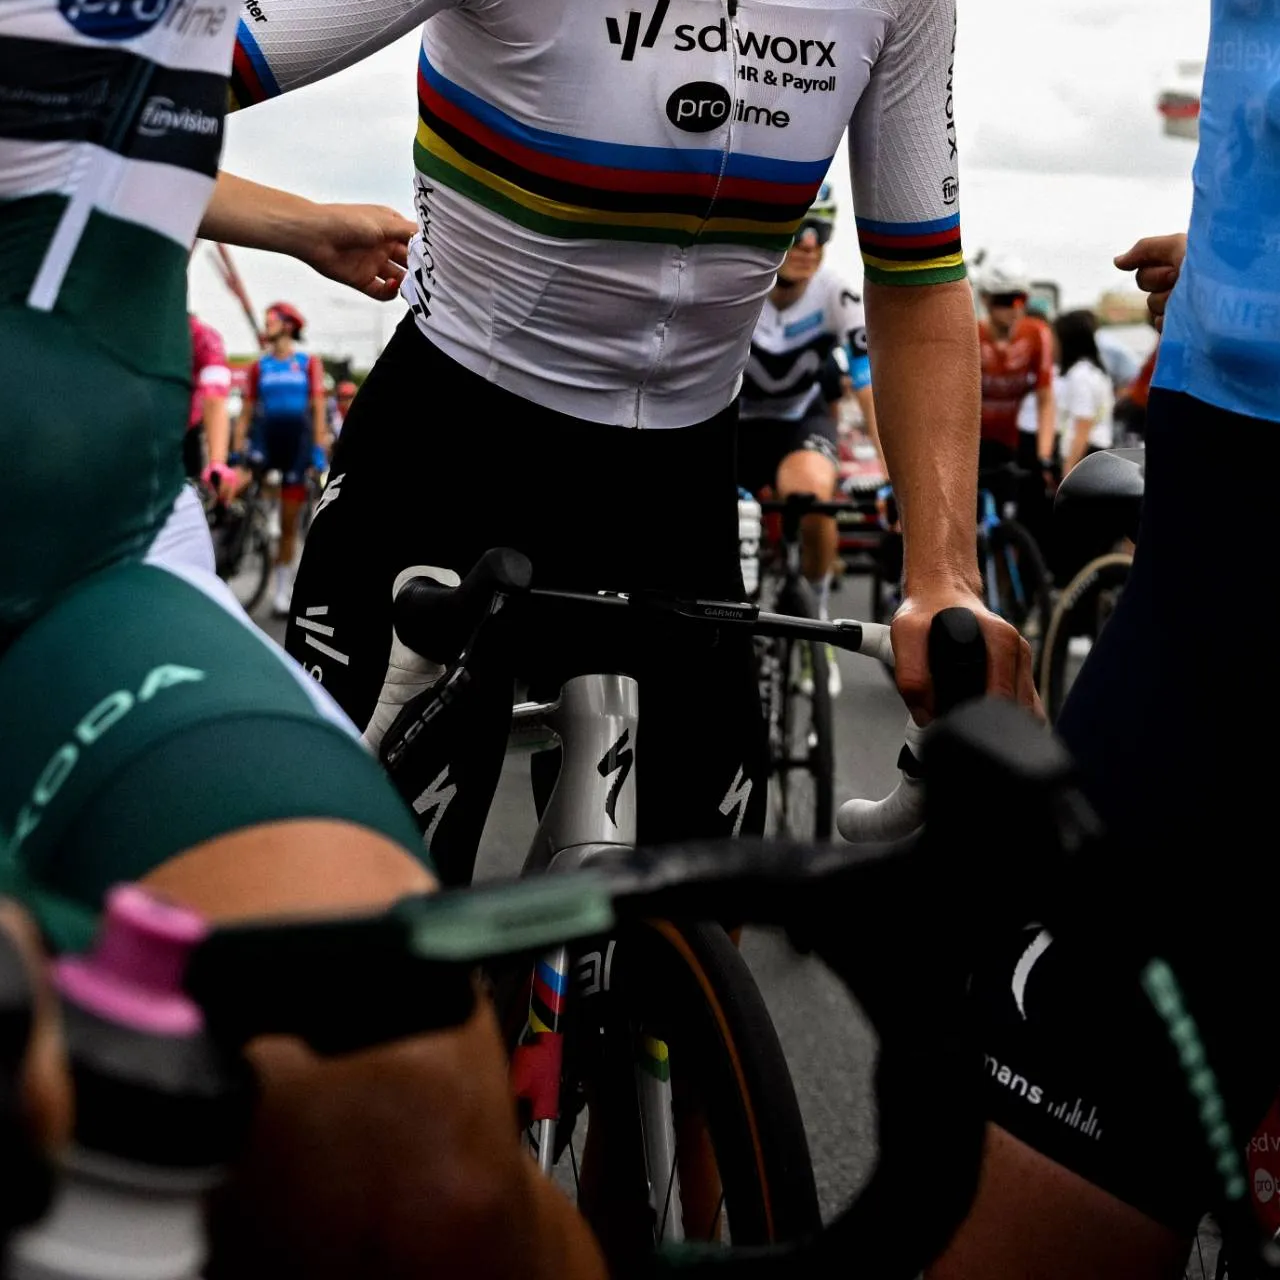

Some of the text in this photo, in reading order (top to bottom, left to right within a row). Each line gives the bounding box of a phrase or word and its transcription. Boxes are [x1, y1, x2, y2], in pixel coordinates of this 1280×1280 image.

[673, 17, 837, 68] sdworx
[737, 64, 836, 94] HR & Payroll
[677, 97, 790, 128] protime
[704, 606, 744, 619] GARMIN
